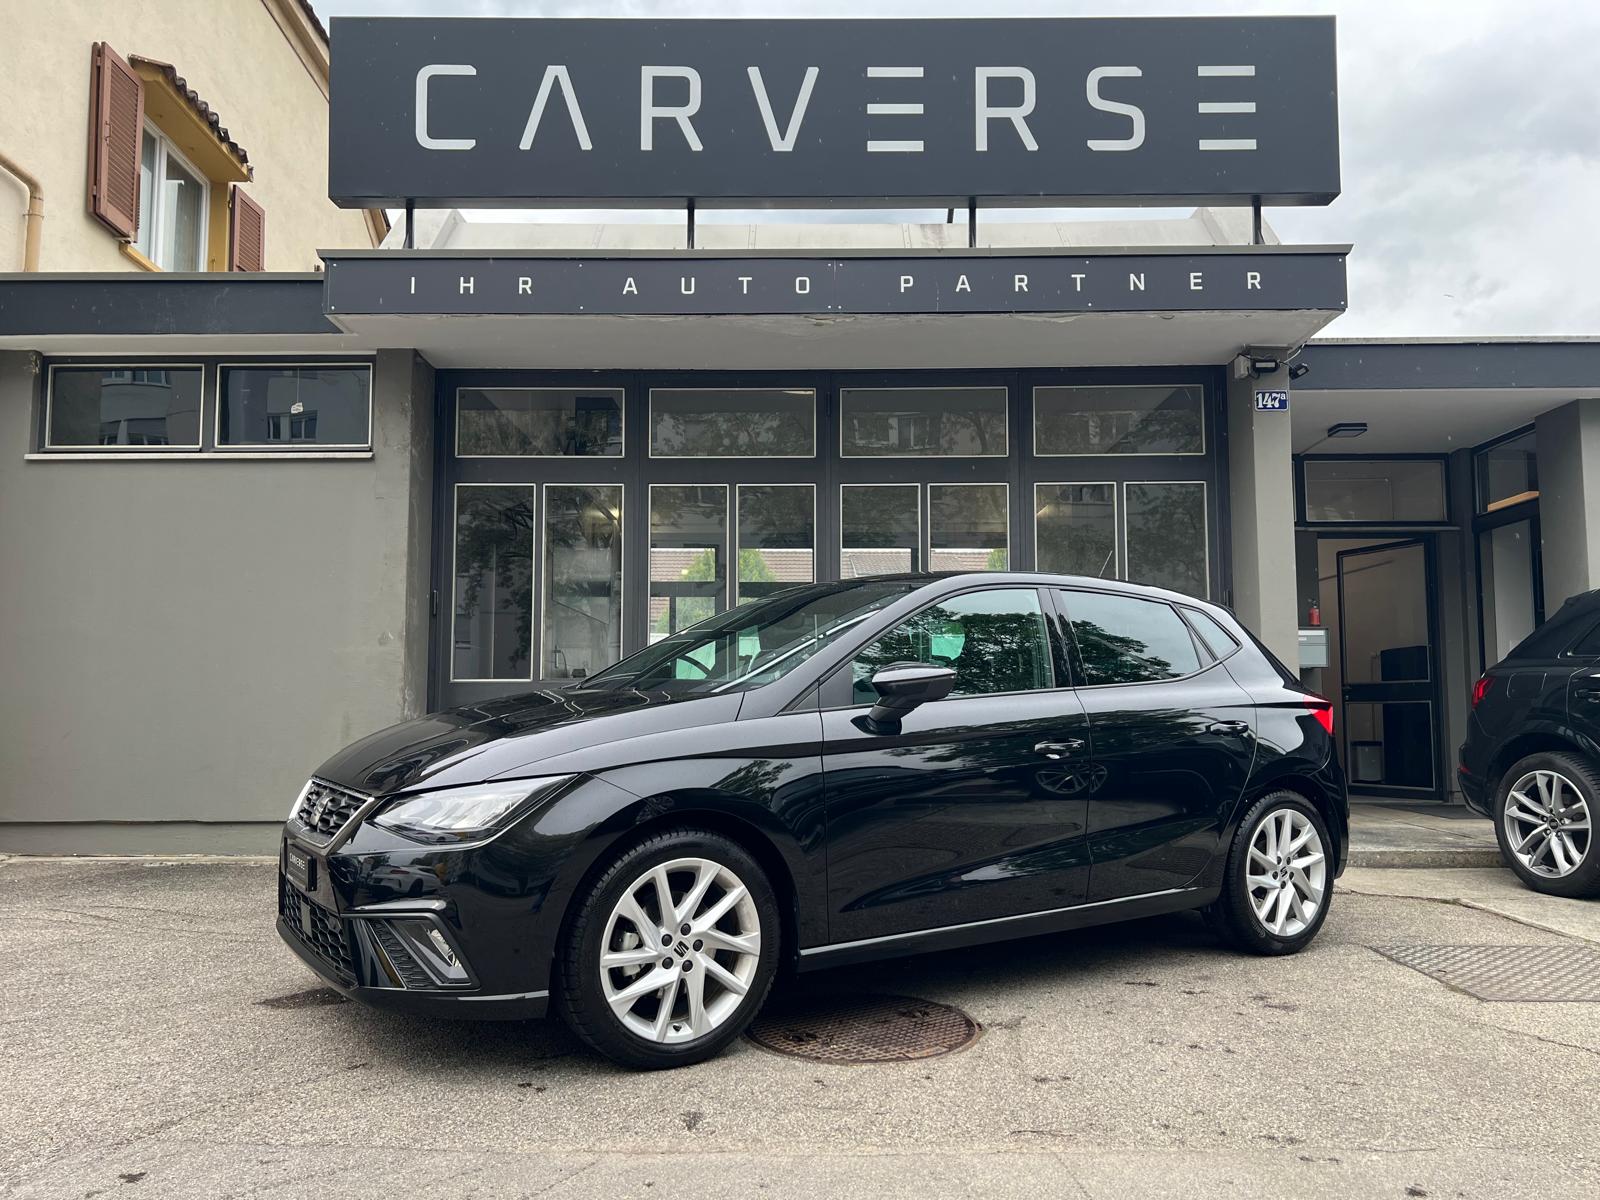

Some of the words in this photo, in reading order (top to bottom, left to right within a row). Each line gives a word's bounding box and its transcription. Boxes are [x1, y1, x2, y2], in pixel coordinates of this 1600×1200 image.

[416, 65, 1256, 151] CARVERSE
[410, 277, 532, 295] IHR
[622, 277, 810, 295] AUTO
[900, 271, 1262, 293] PARTNER
